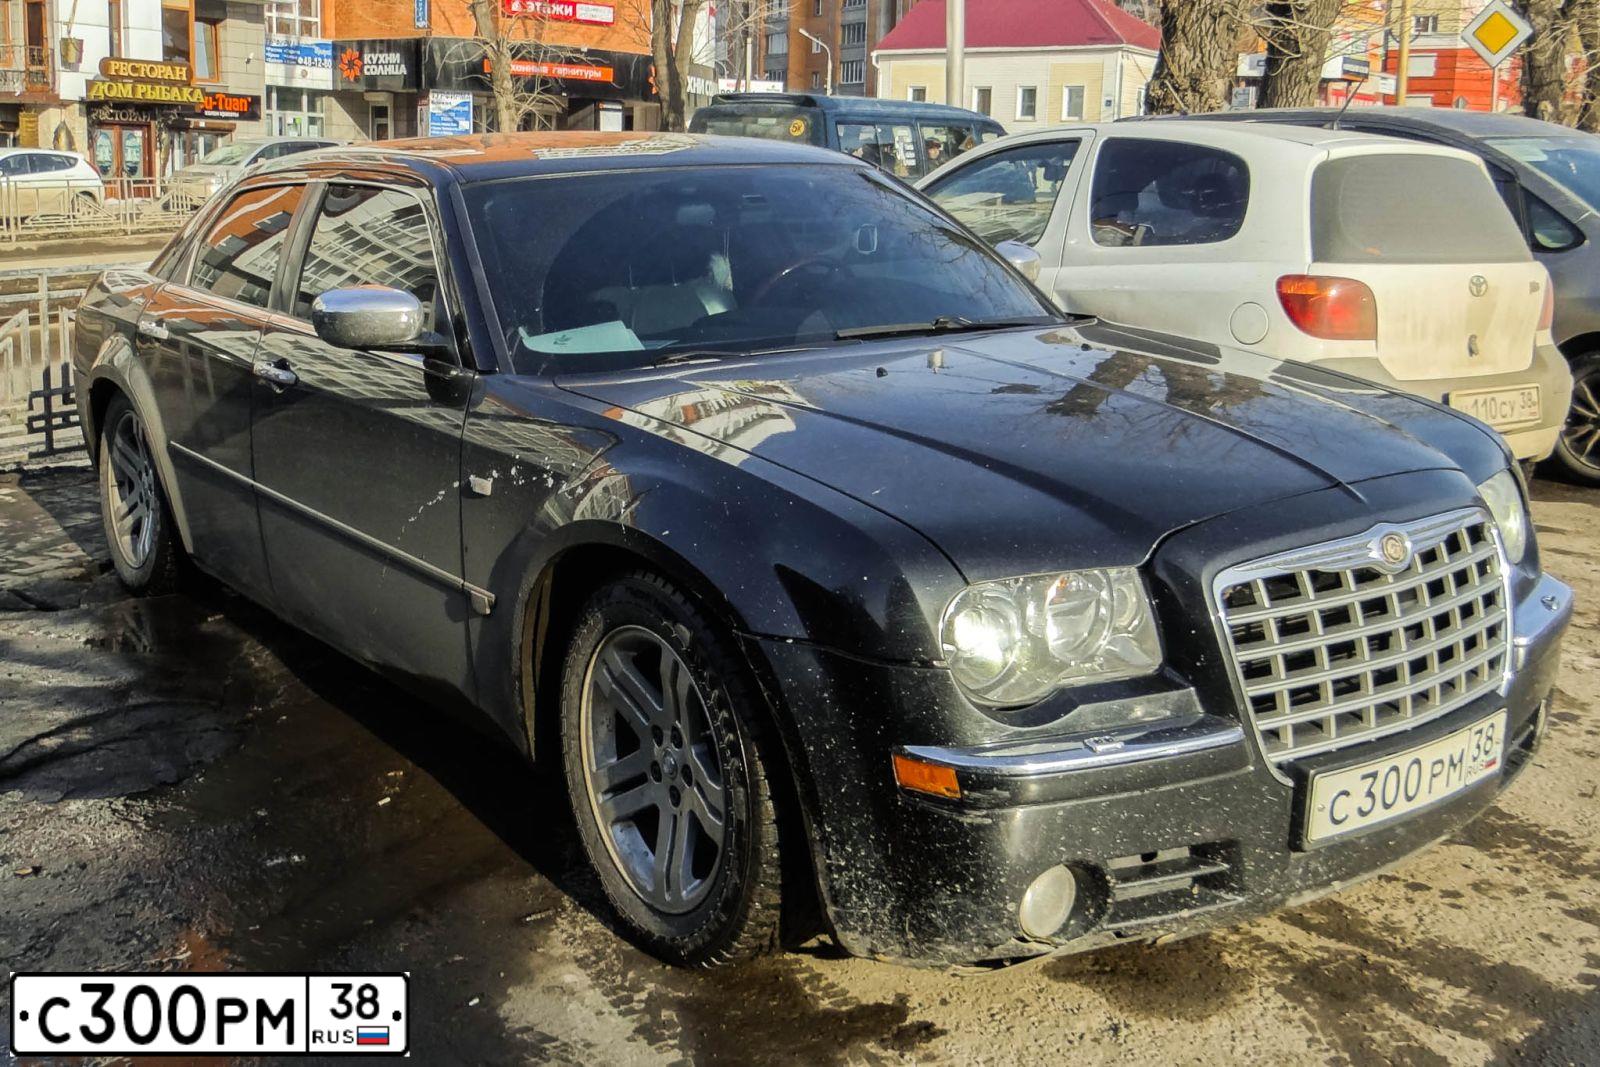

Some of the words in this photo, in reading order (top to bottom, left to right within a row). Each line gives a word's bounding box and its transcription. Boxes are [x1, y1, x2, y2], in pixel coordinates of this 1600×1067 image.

[364, 53, 400, 64] КУХНИ
[109, 60, 187, 80] РЕСТОРАН
[364, 64, 407, 75] СОЛНЦА
[511, 63, 549, 74] хонные
[552, 67, 602, 78] гарнитуры
[89, 81, 133, 99] ДОМ
[135, 83, 205, 102] РЫБАКА
[202, 93, 248, 111] u-Tuan
[1472, 397, 1516, 420] 110СУ
[1329, 748, 1465, 826] С300РМ
[1472, 722, 1495, 762] 38
